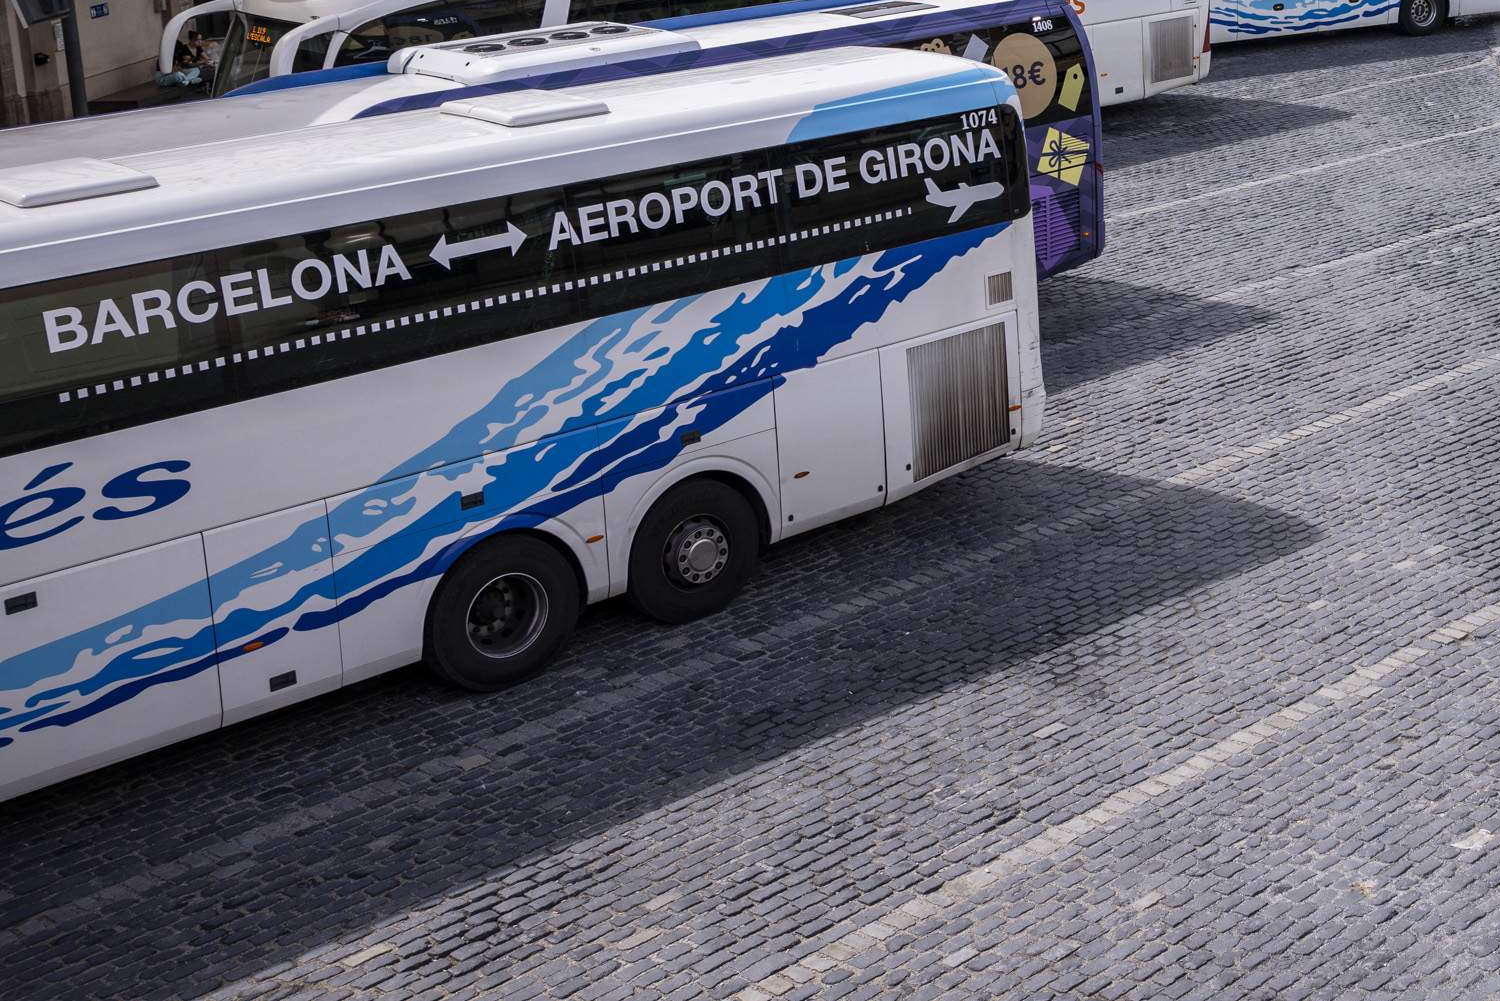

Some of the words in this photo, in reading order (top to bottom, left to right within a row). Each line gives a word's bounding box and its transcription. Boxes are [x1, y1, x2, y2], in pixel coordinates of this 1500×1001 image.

[1032, 19, 1054, 33] 1408
[959, 107, 999, 132] 1074
[548, 167, 784, 252] AEROPORT
[794, 155, 850, 200] DE
[859, 129, 1001, 187] GIRONA
[41, 243, 412, 354] BARCELONA
